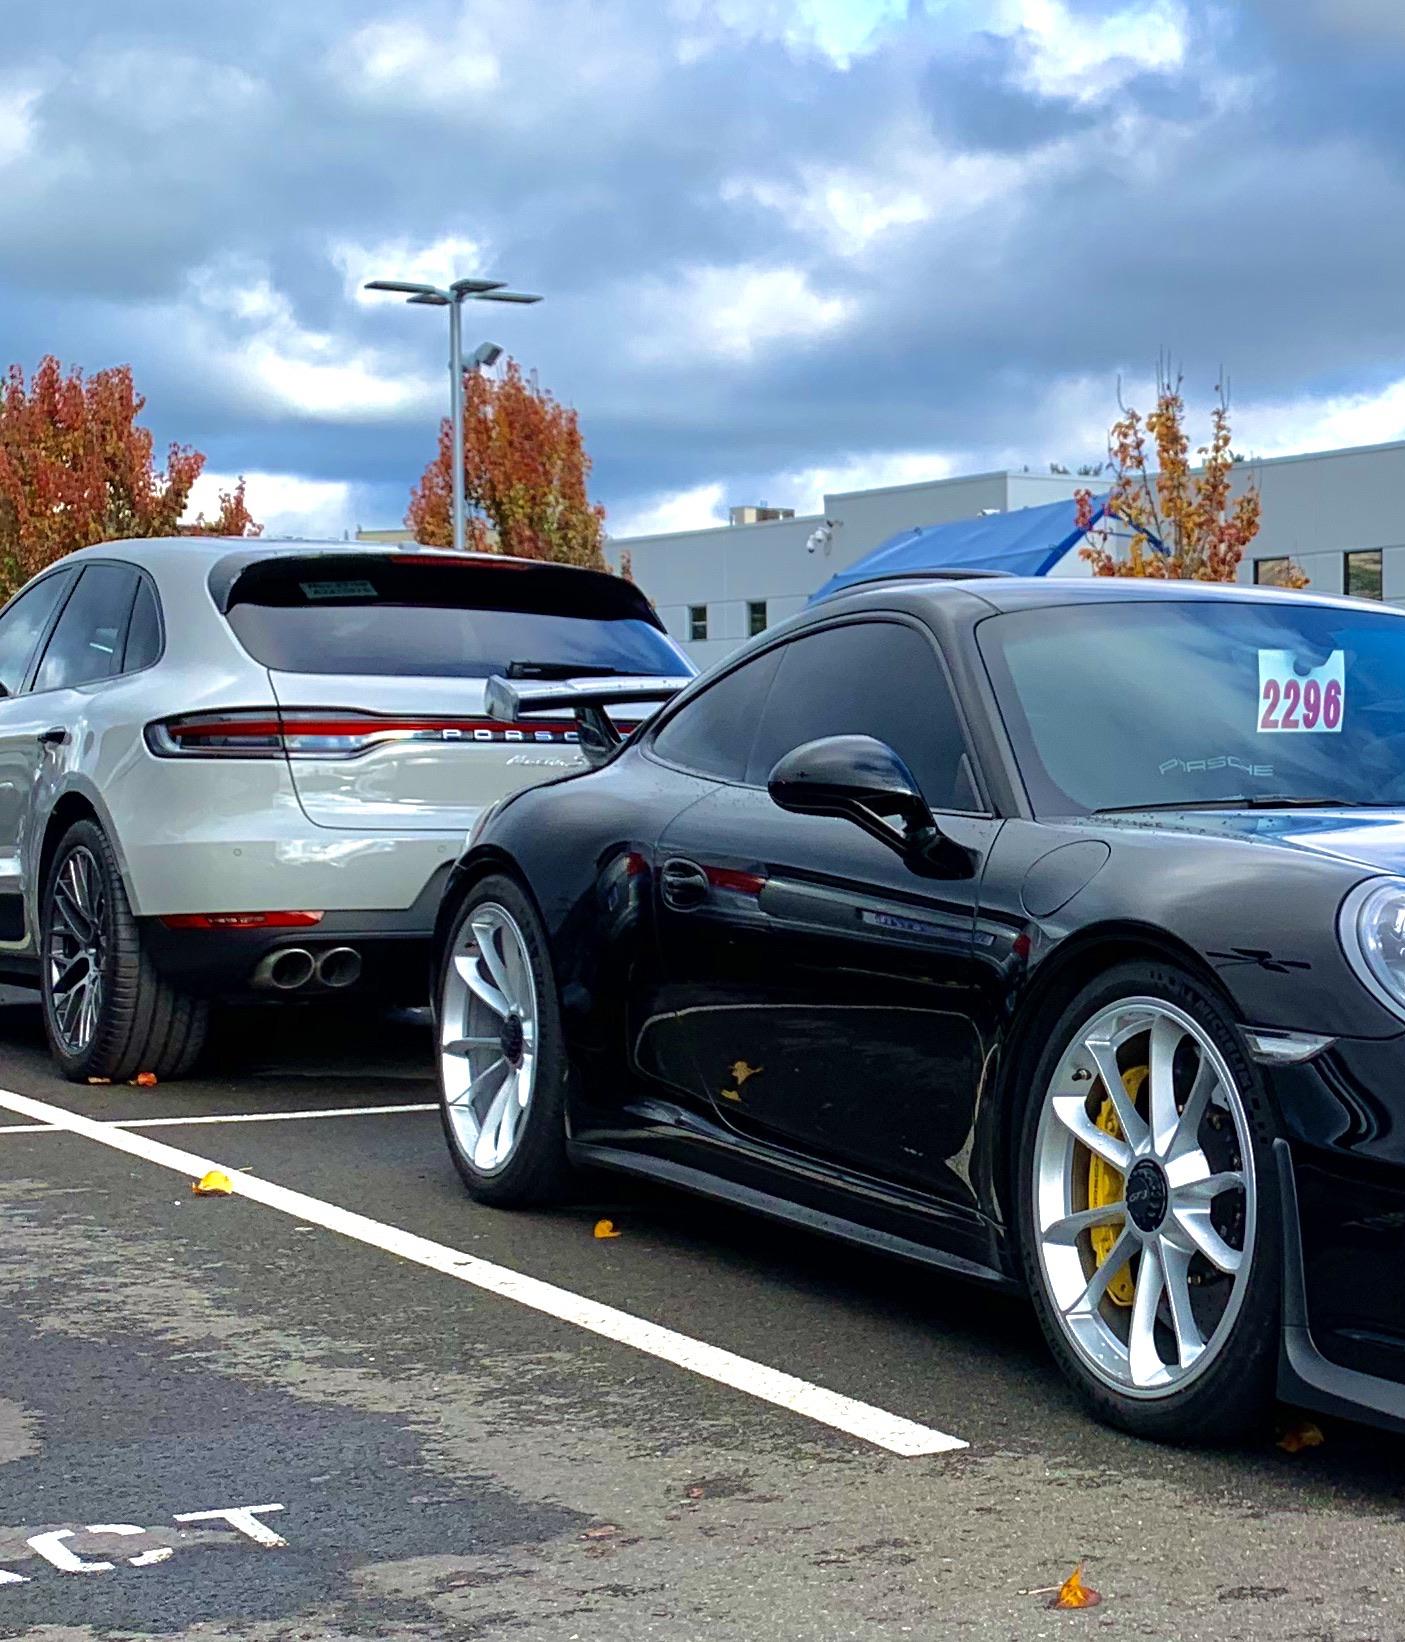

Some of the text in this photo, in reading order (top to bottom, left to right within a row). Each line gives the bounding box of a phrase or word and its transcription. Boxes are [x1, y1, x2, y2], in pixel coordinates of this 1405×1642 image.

[1260, 679, 1342, 729] 2296
[442, 729, 631, 742] PORSC
[0, 1503, 290, 1585] CT
